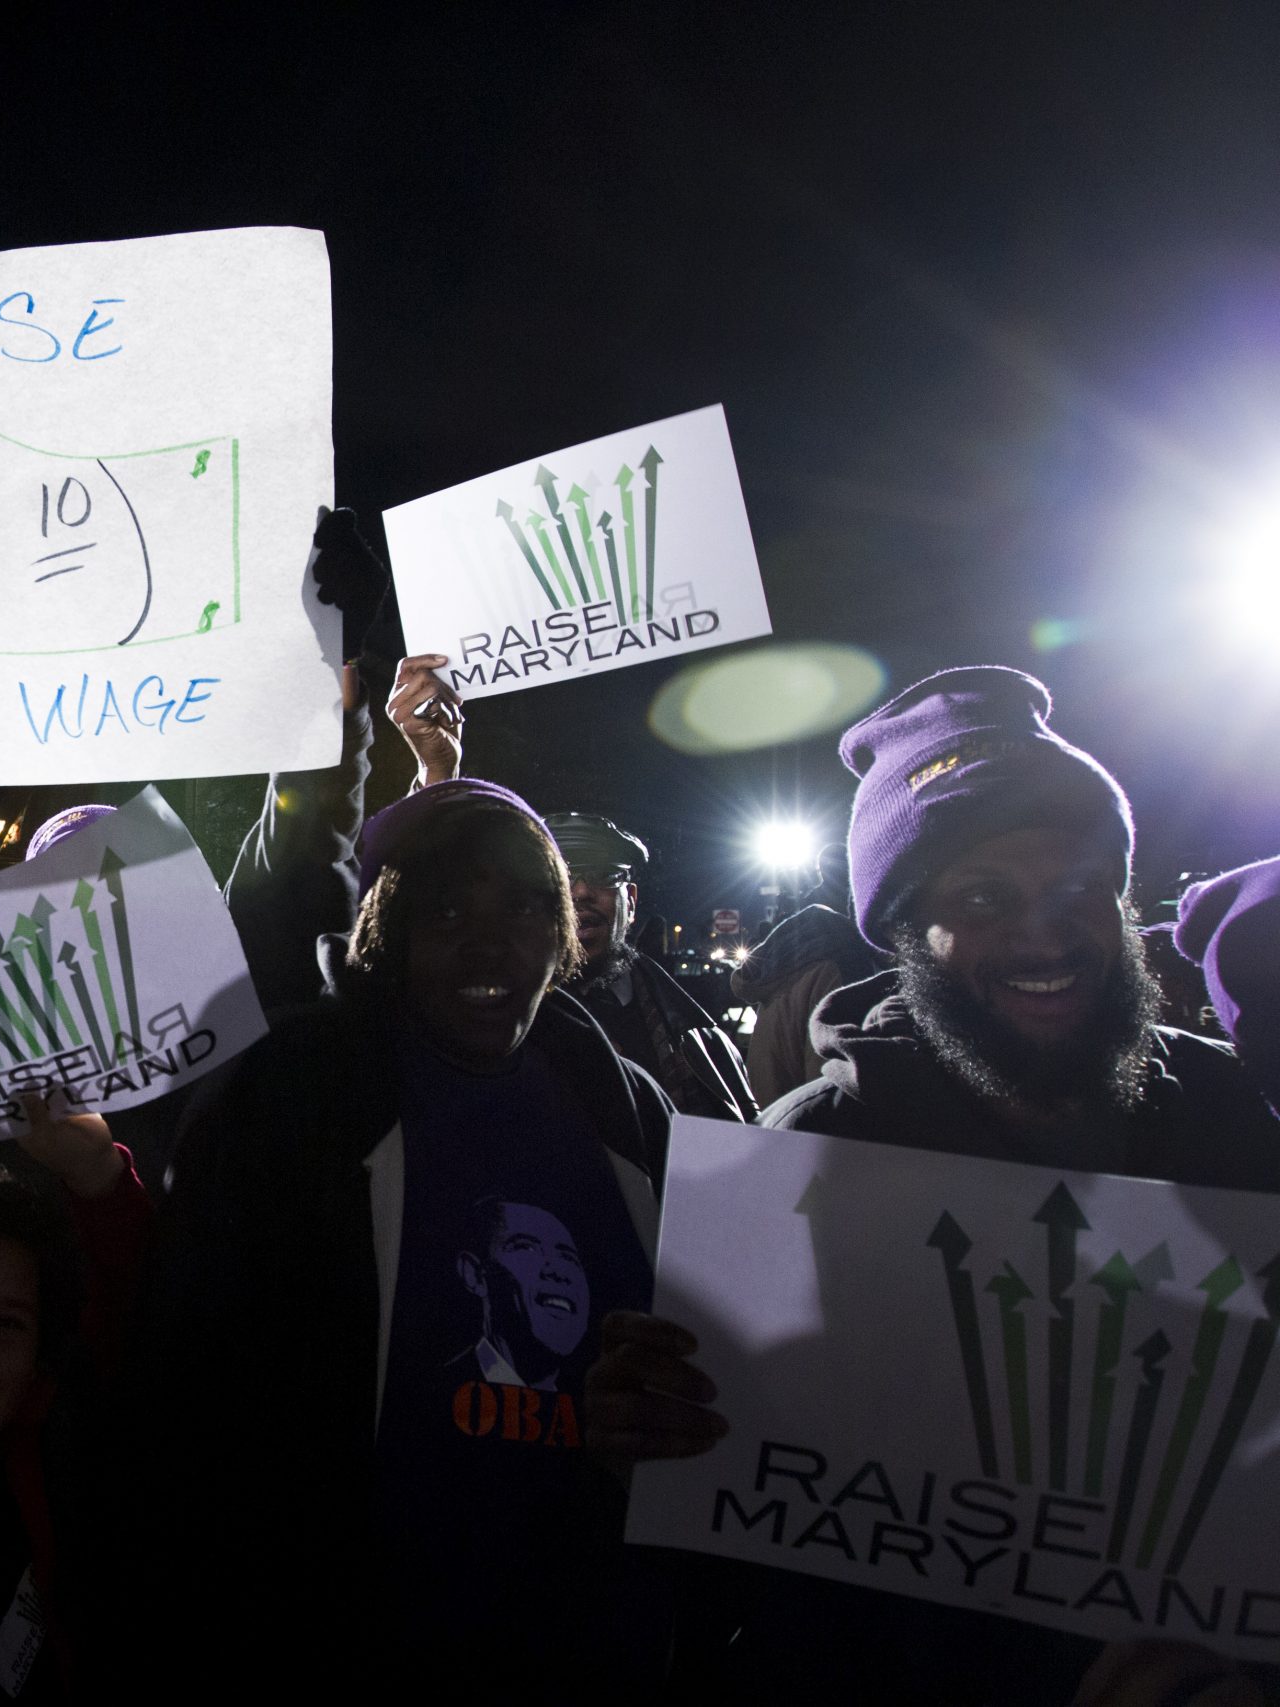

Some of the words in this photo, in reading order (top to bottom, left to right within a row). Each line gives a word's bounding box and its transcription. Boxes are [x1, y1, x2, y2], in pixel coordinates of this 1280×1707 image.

[42, 477, 91, 538] 10
[449, 610, 719, 691] MARYLAND
[460, 601, 618, 664] RAISE
[19, 674, 221, 745] WAGE
[451, 1379, 582, 1450] OBA
[755, 1441, 1107, 1561] RAISE
[712, 1489, 1280, 1640] MARYLAND
